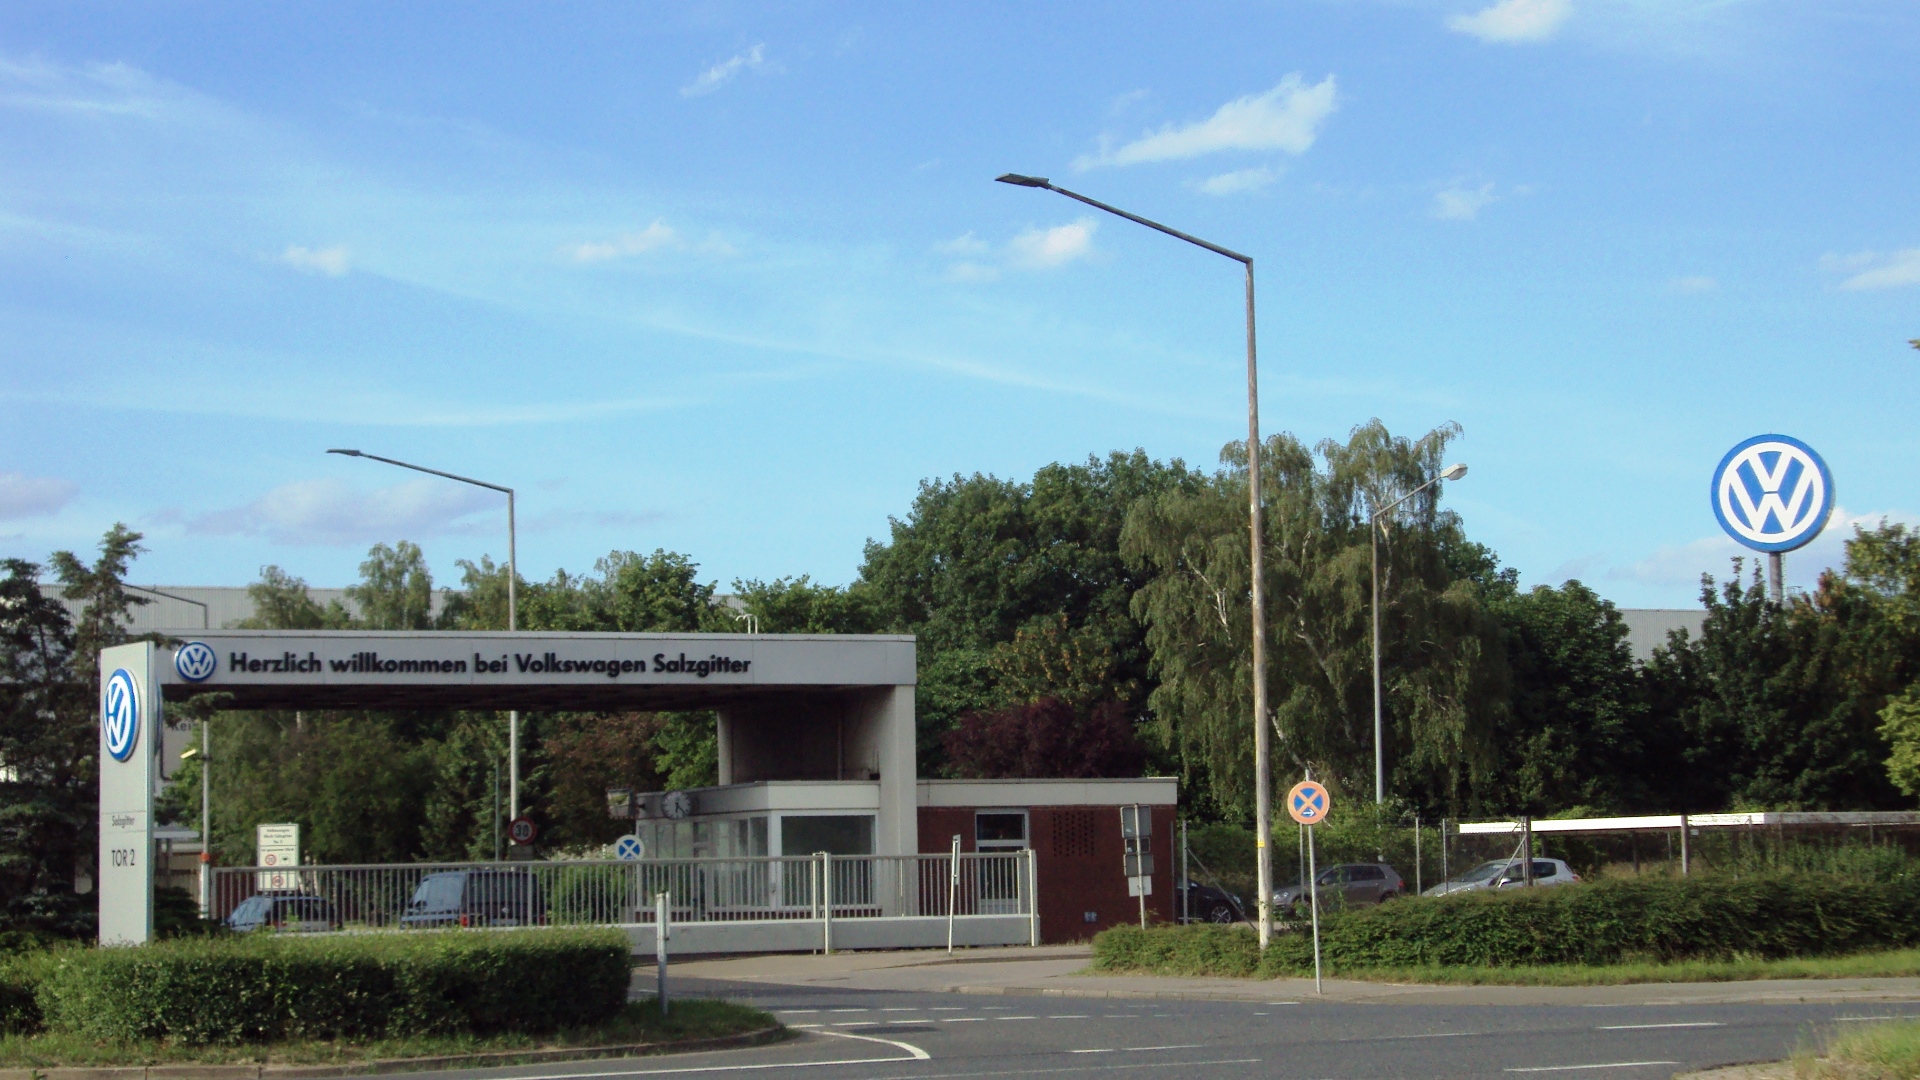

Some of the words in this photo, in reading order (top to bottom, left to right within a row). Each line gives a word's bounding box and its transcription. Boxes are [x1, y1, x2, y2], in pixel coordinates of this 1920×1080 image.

[230, 652, 322, 673] Herzlich
[330, 652, 467, 673] willkommen
[475, 653, 508, 673] bei
[515, 653, 647, 678] Volkswagen
[654, 653, 752, 678] Salzgitter
[515, 824, 530, 838] 30
[111, 849, 128, 867] TOR
[130, 848, 135, 866] 2
